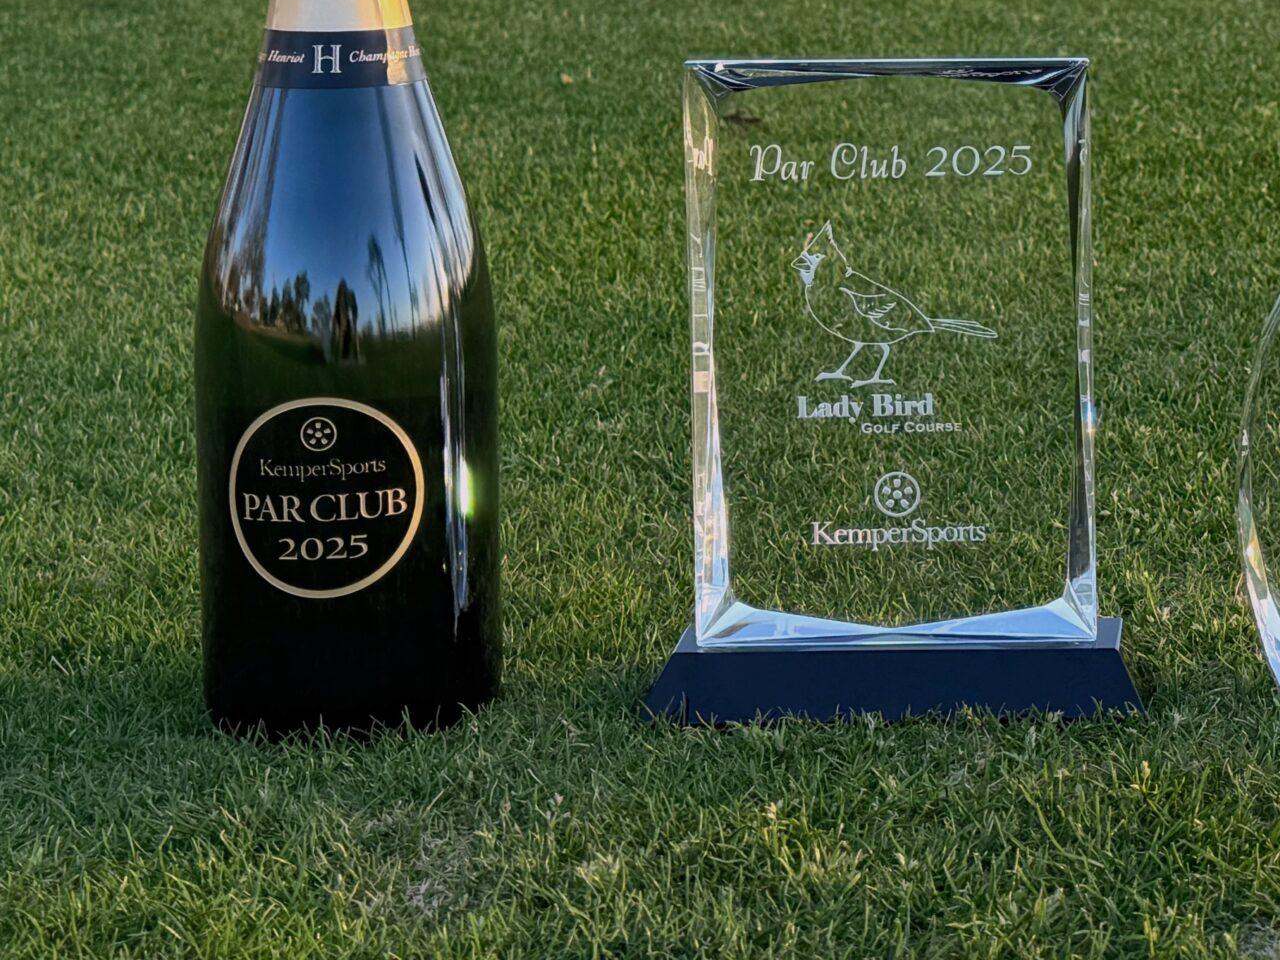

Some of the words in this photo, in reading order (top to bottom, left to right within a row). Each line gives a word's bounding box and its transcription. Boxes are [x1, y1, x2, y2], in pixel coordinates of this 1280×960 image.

[267, 49, 306, 63] Henriot
[312, 44, 342, 74] H
[749, 143, 815, 182] Par
[830, 142, 907, 180] Club
[925, 144, 1033, 177] 2025
[796, 394, 864, 424] Lady
[870, 392, 935, 417] Bird
[861, 422, 901, 434] GOLF
[903, 421, 963, 433] COURSE
[259, 457, 387, 483] KemperSports
[242, 492, 306, 523] PAR
[309, 487, 408, 523] CLUB
[277, 533, 369, 561] 2025
[810, 517, 987, 552] KemperSports
